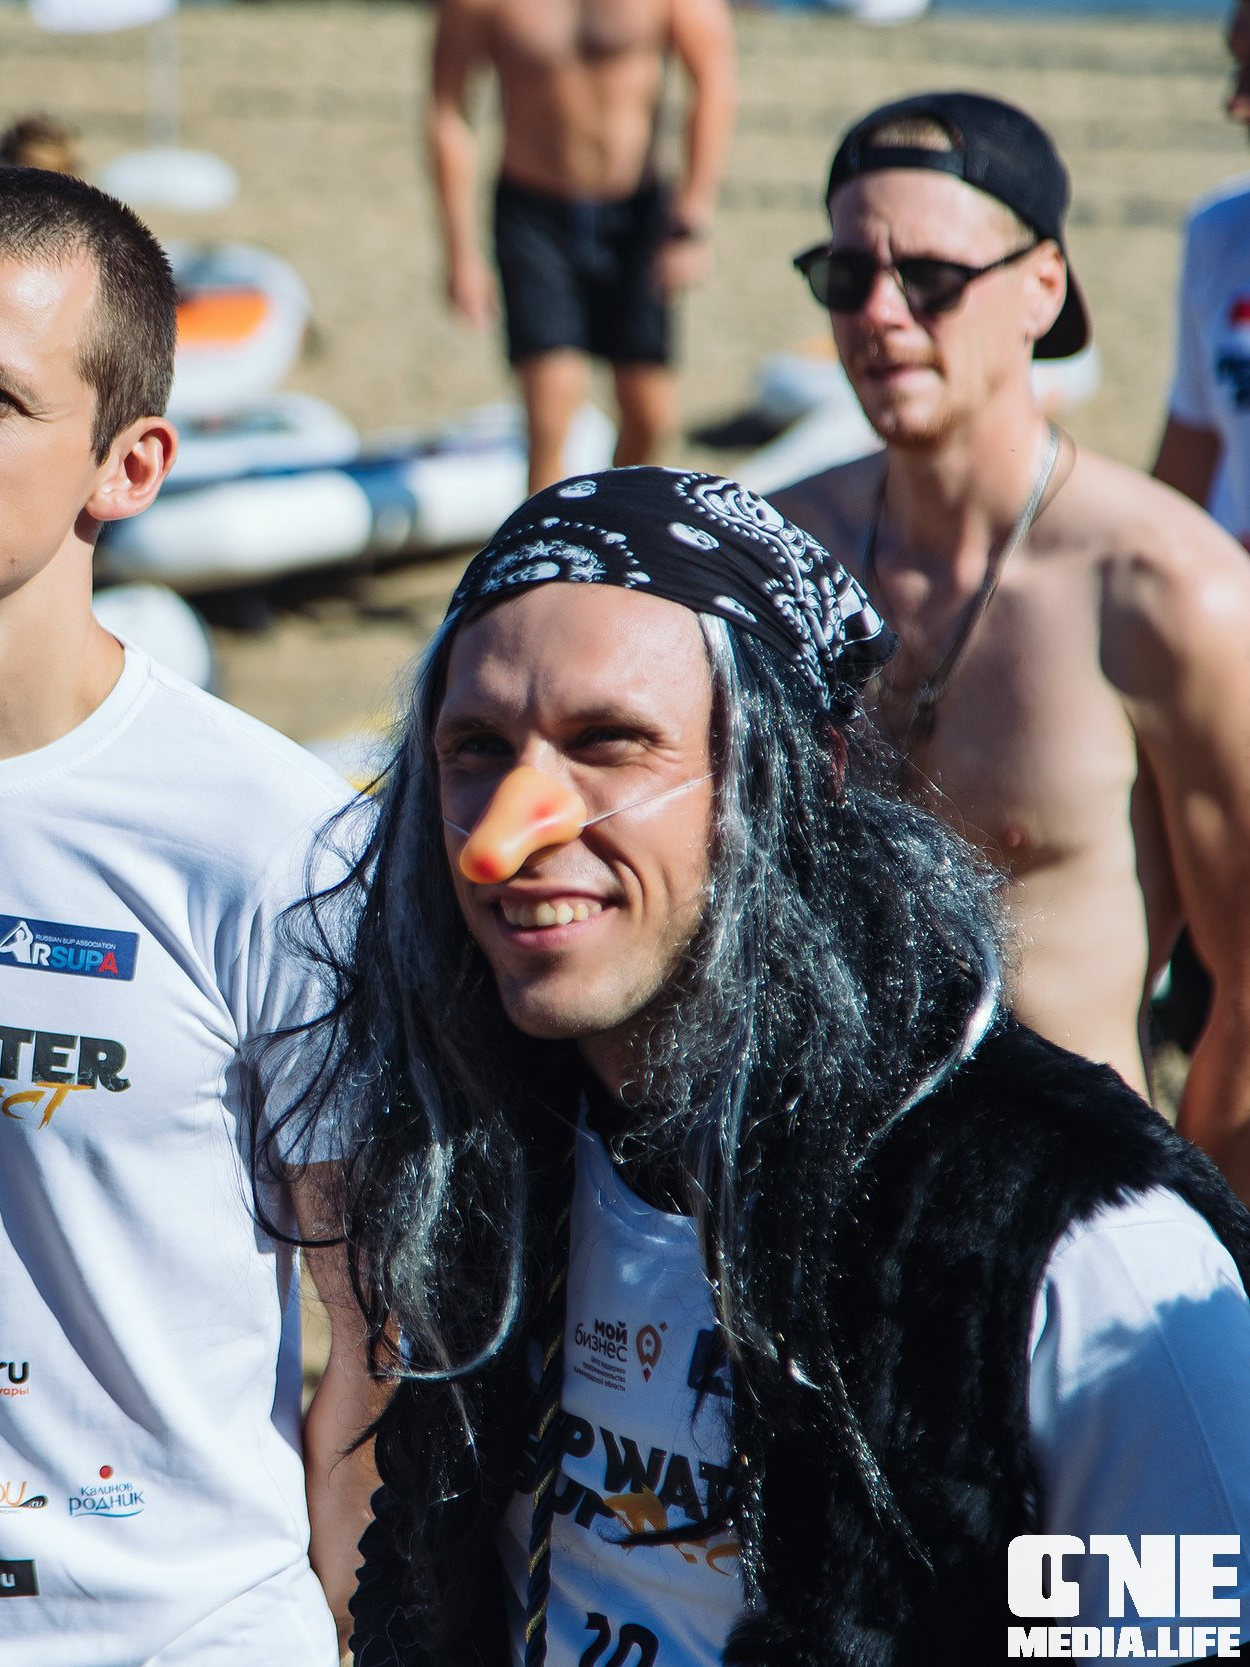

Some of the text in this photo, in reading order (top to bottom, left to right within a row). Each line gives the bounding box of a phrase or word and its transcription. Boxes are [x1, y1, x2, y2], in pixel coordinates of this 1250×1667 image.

[35, 934, 62, 944] RUSSIAN
[76, 939, 116, 950] ASSOCIATION
[575, 1323, 628, 1363] бизнес
[594, 1318, 628, 1345] мой
